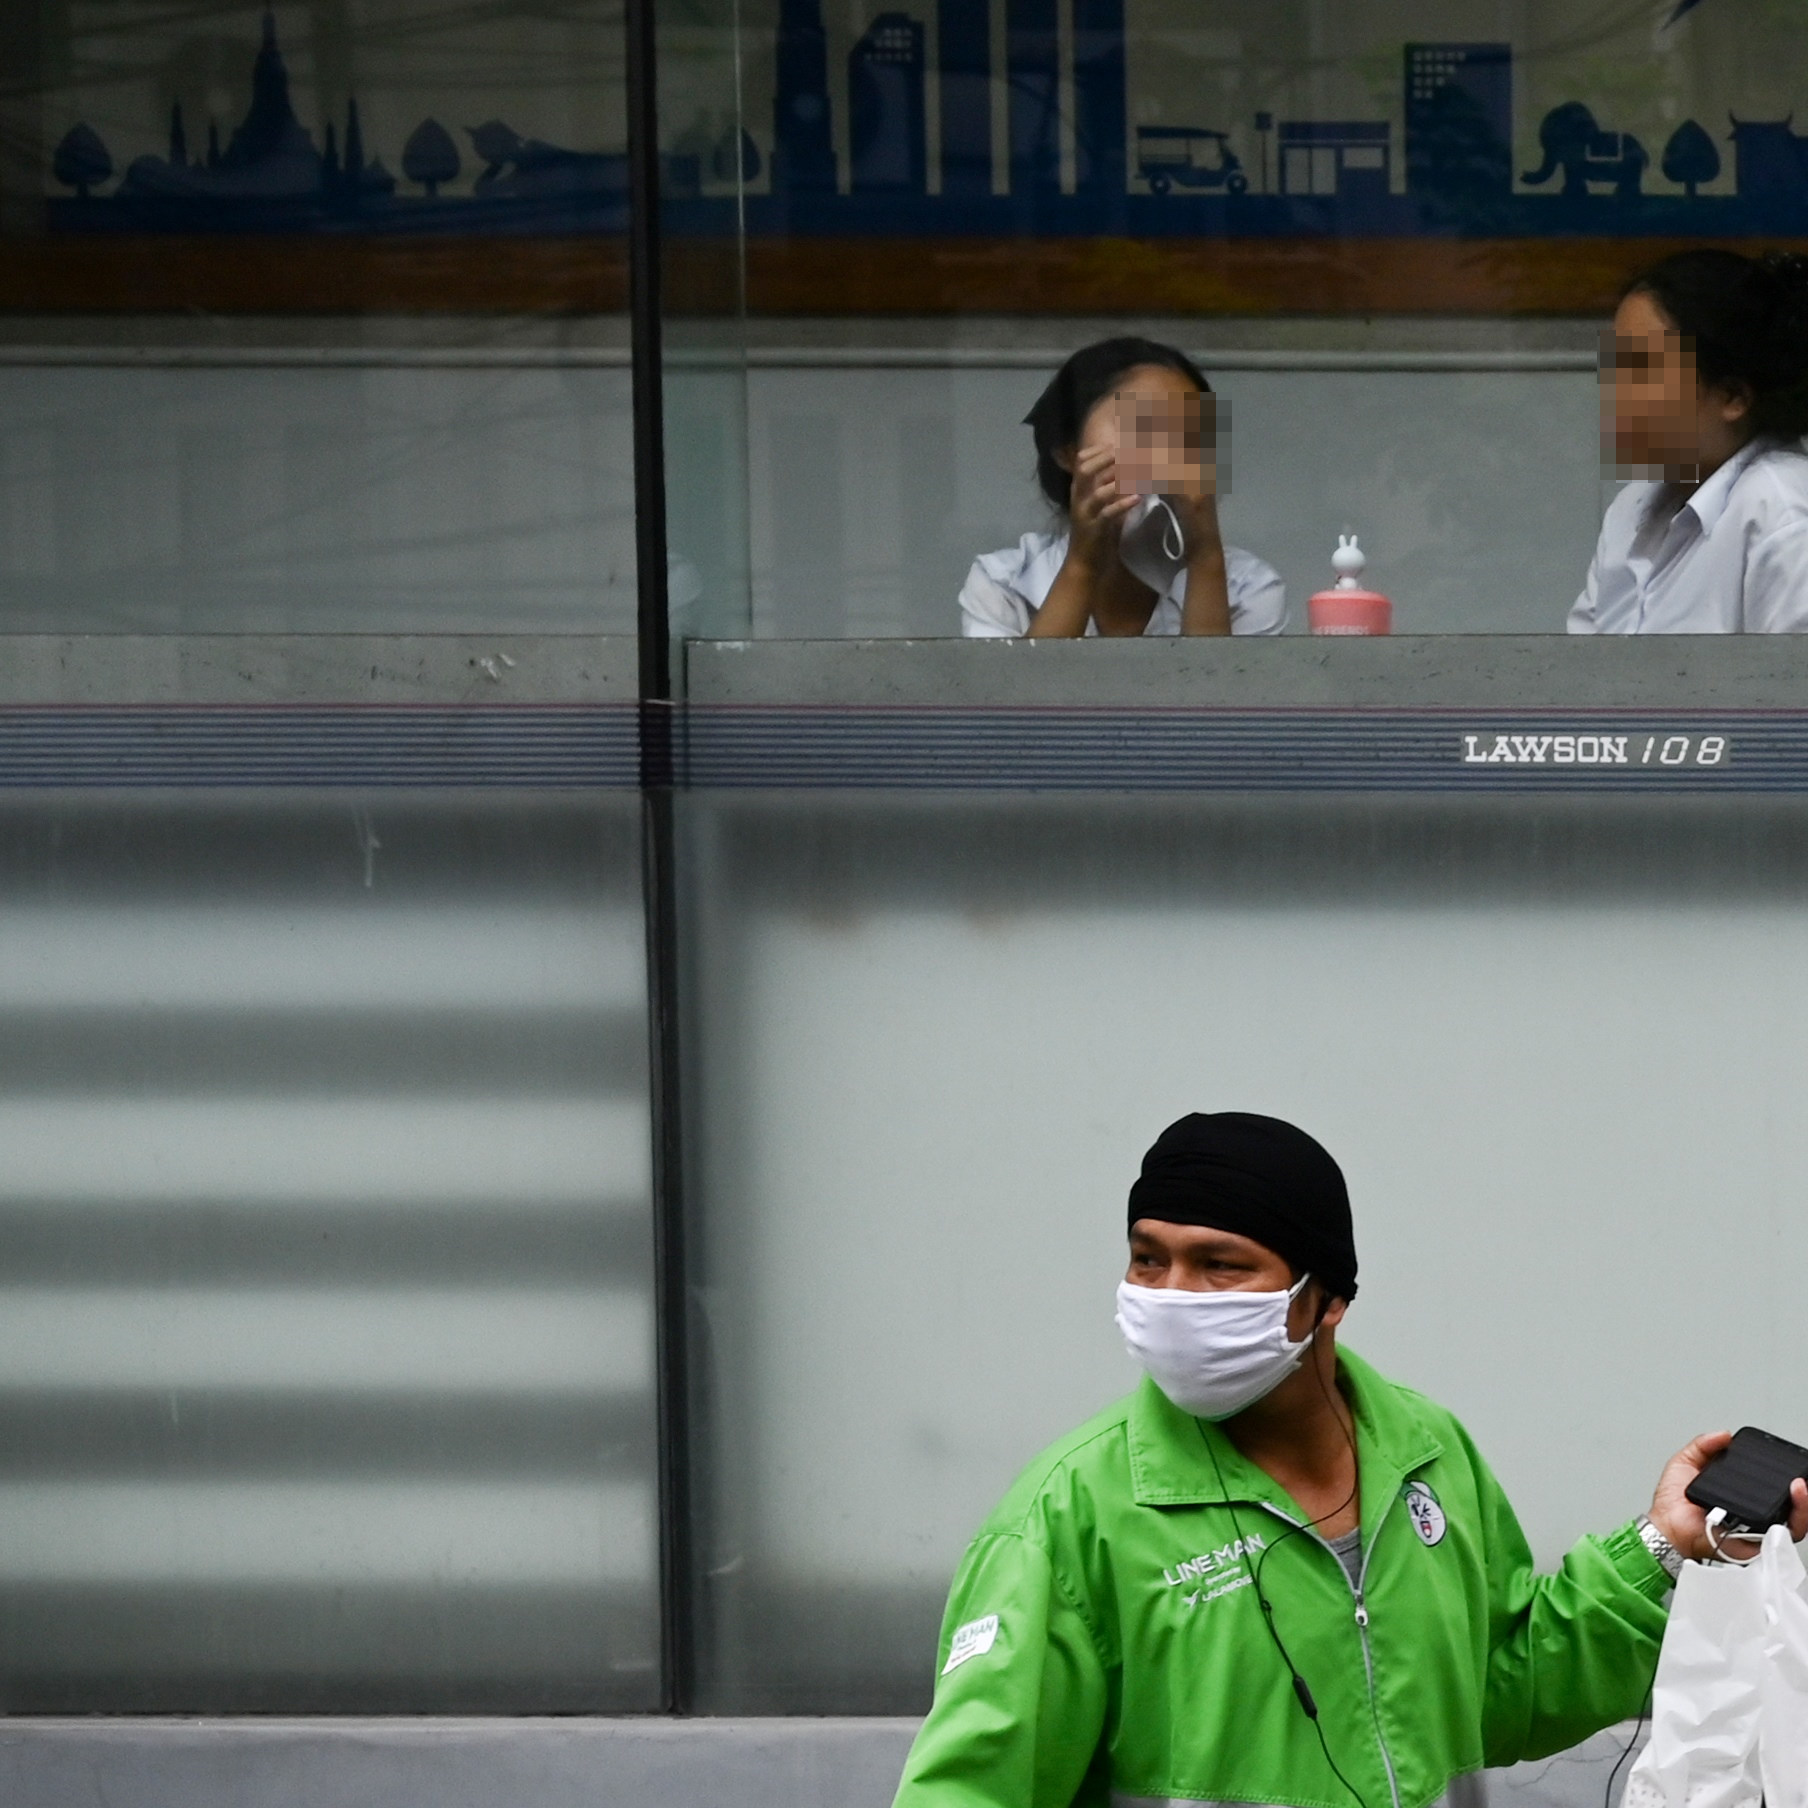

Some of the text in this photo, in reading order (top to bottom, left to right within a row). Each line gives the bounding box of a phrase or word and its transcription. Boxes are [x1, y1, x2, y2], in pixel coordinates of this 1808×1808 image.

[1464, 735, 1726, 765] LAWSON 108
[1163, 1553, 1216, 1585] LINE
[1212, 1533, 1267, 1567] MAN
